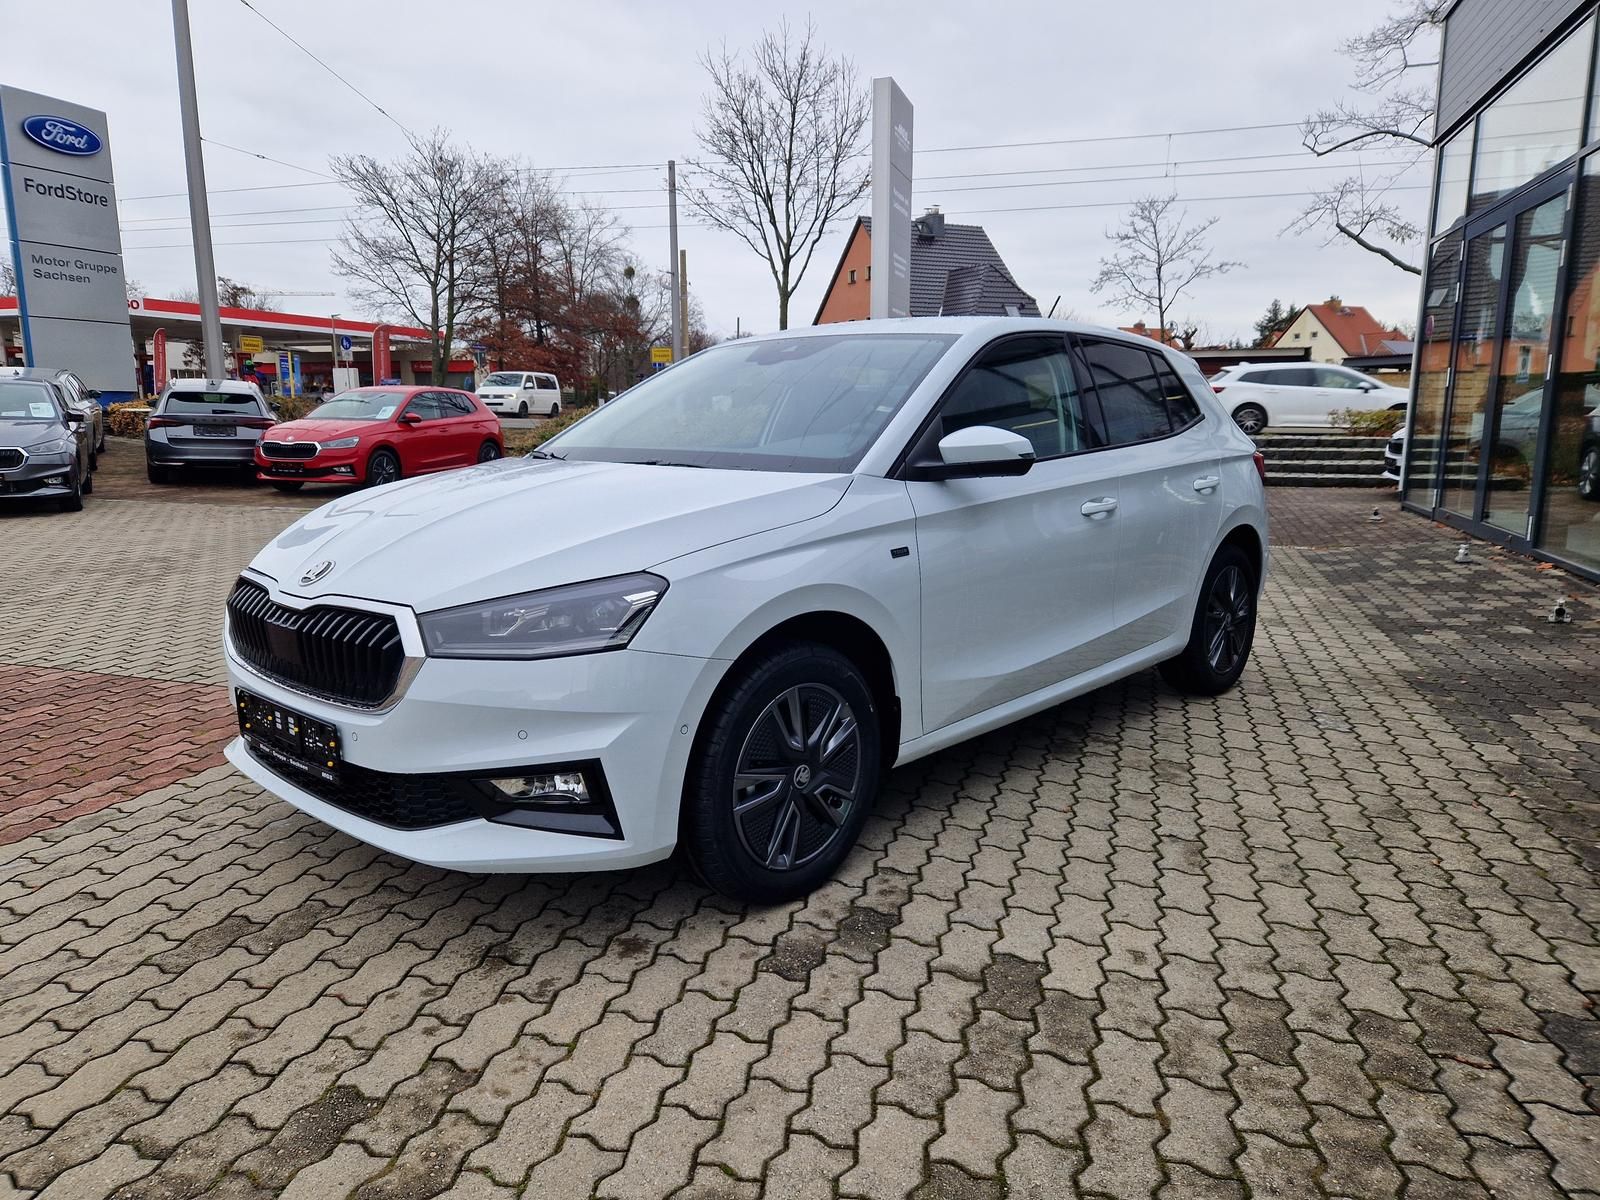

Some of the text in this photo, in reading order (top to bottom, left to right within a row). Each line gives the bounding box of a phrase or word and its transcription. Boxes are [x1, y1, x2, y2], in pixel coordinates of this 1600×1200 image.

[41, 120, 89, 150] Ford
[23, 177, 109, 207] FordStore
[31, 253, 118, 274] Motor Gruppe
[32, 268, 91, 284] Sachsen
